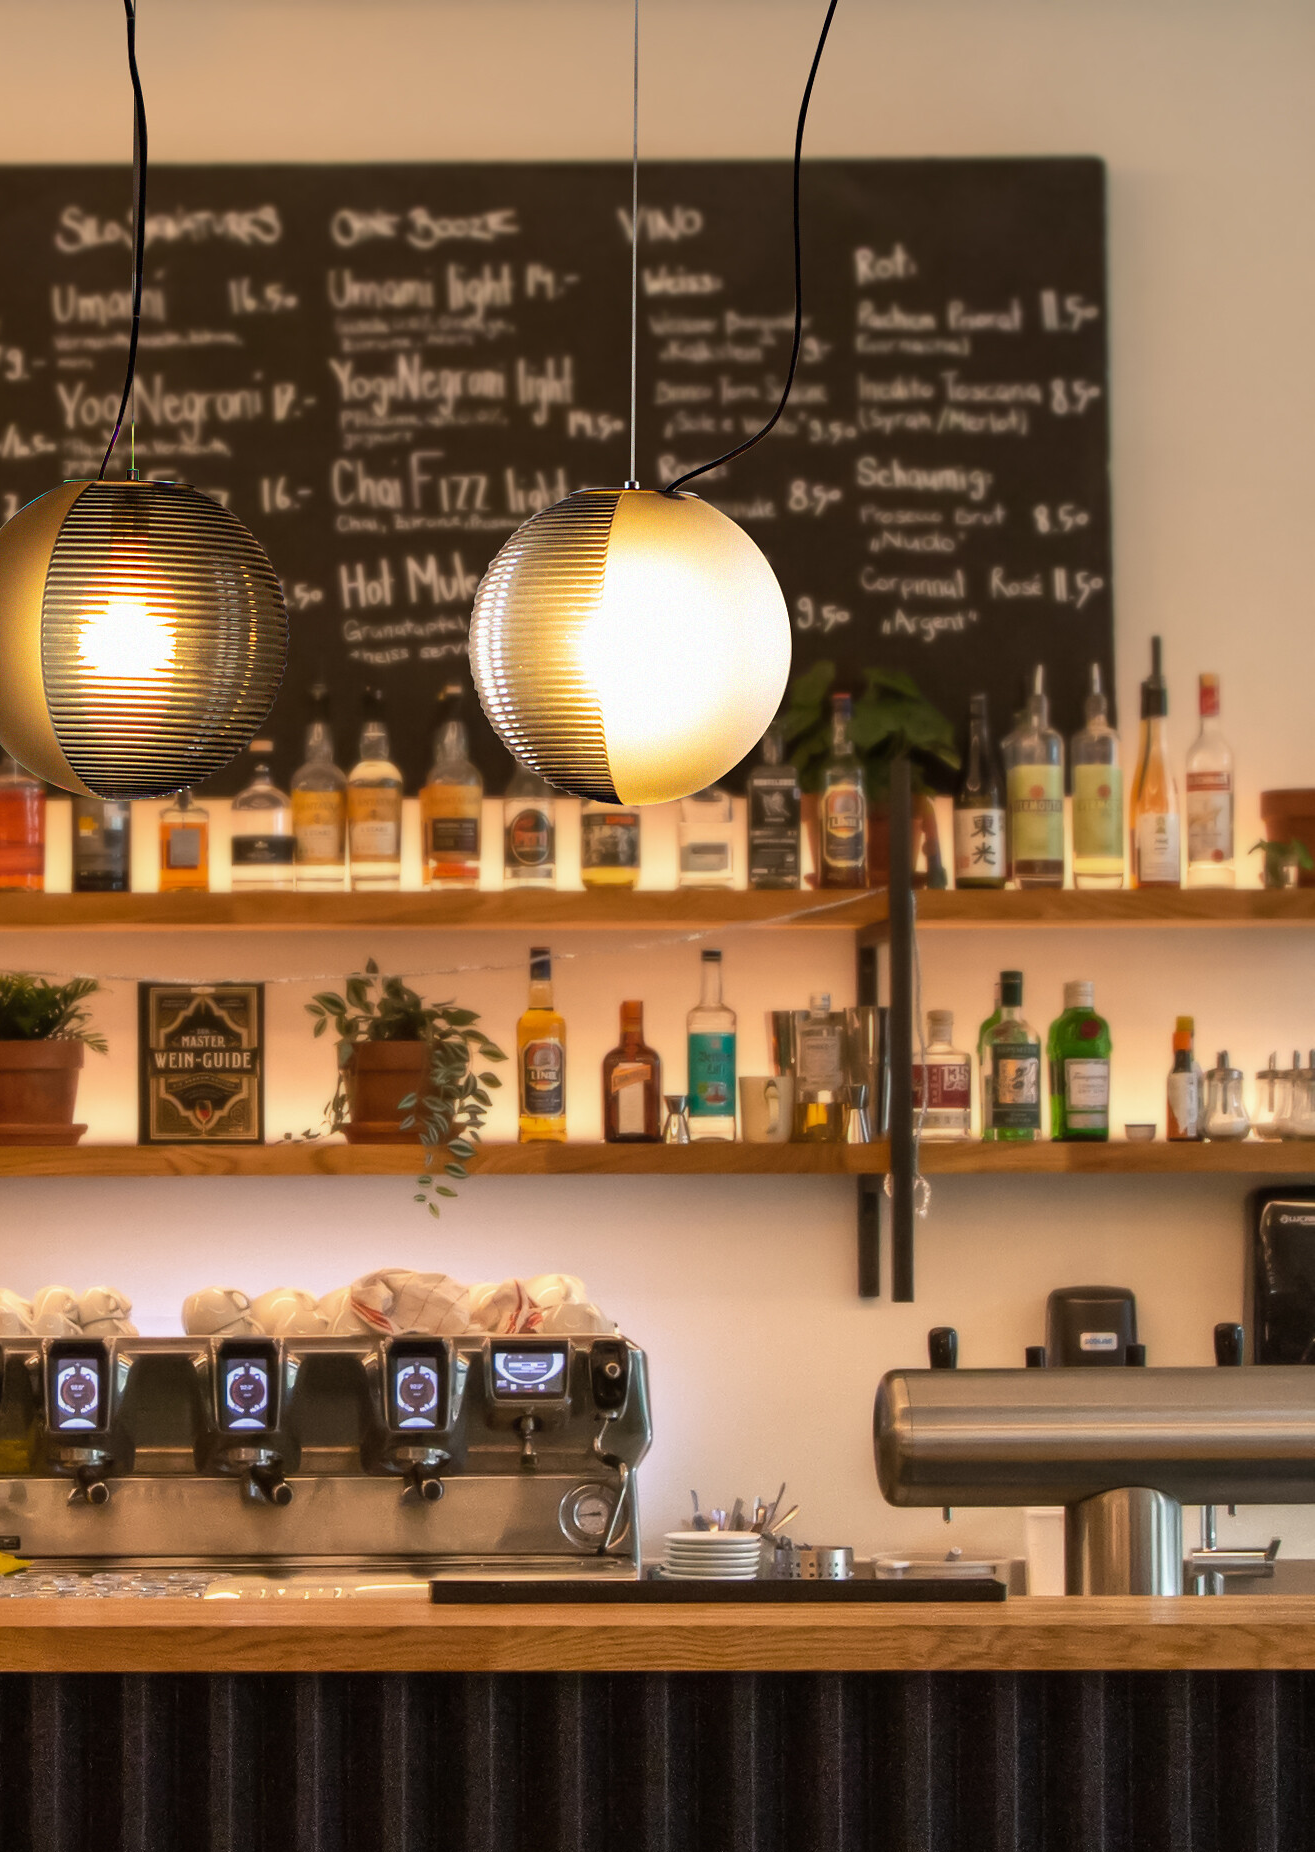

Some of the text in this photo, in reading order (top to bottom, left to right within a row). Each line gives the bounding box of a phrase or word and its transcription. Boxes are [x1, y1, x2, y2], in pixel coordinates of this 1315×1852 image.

[617, 206, 704, 243] VINO
[446, 262, 513, 324] light
[516, 353, 573, 426] light
[940, 369, 1043, 406] Toscana
[333, 458, 404, 510] Chai
[340, 552, 479, 610] Hot Mule
[154, 1052, 252, 1069] WEIN-GUIDE
[181, 1036, 226, 1048] MASTER
